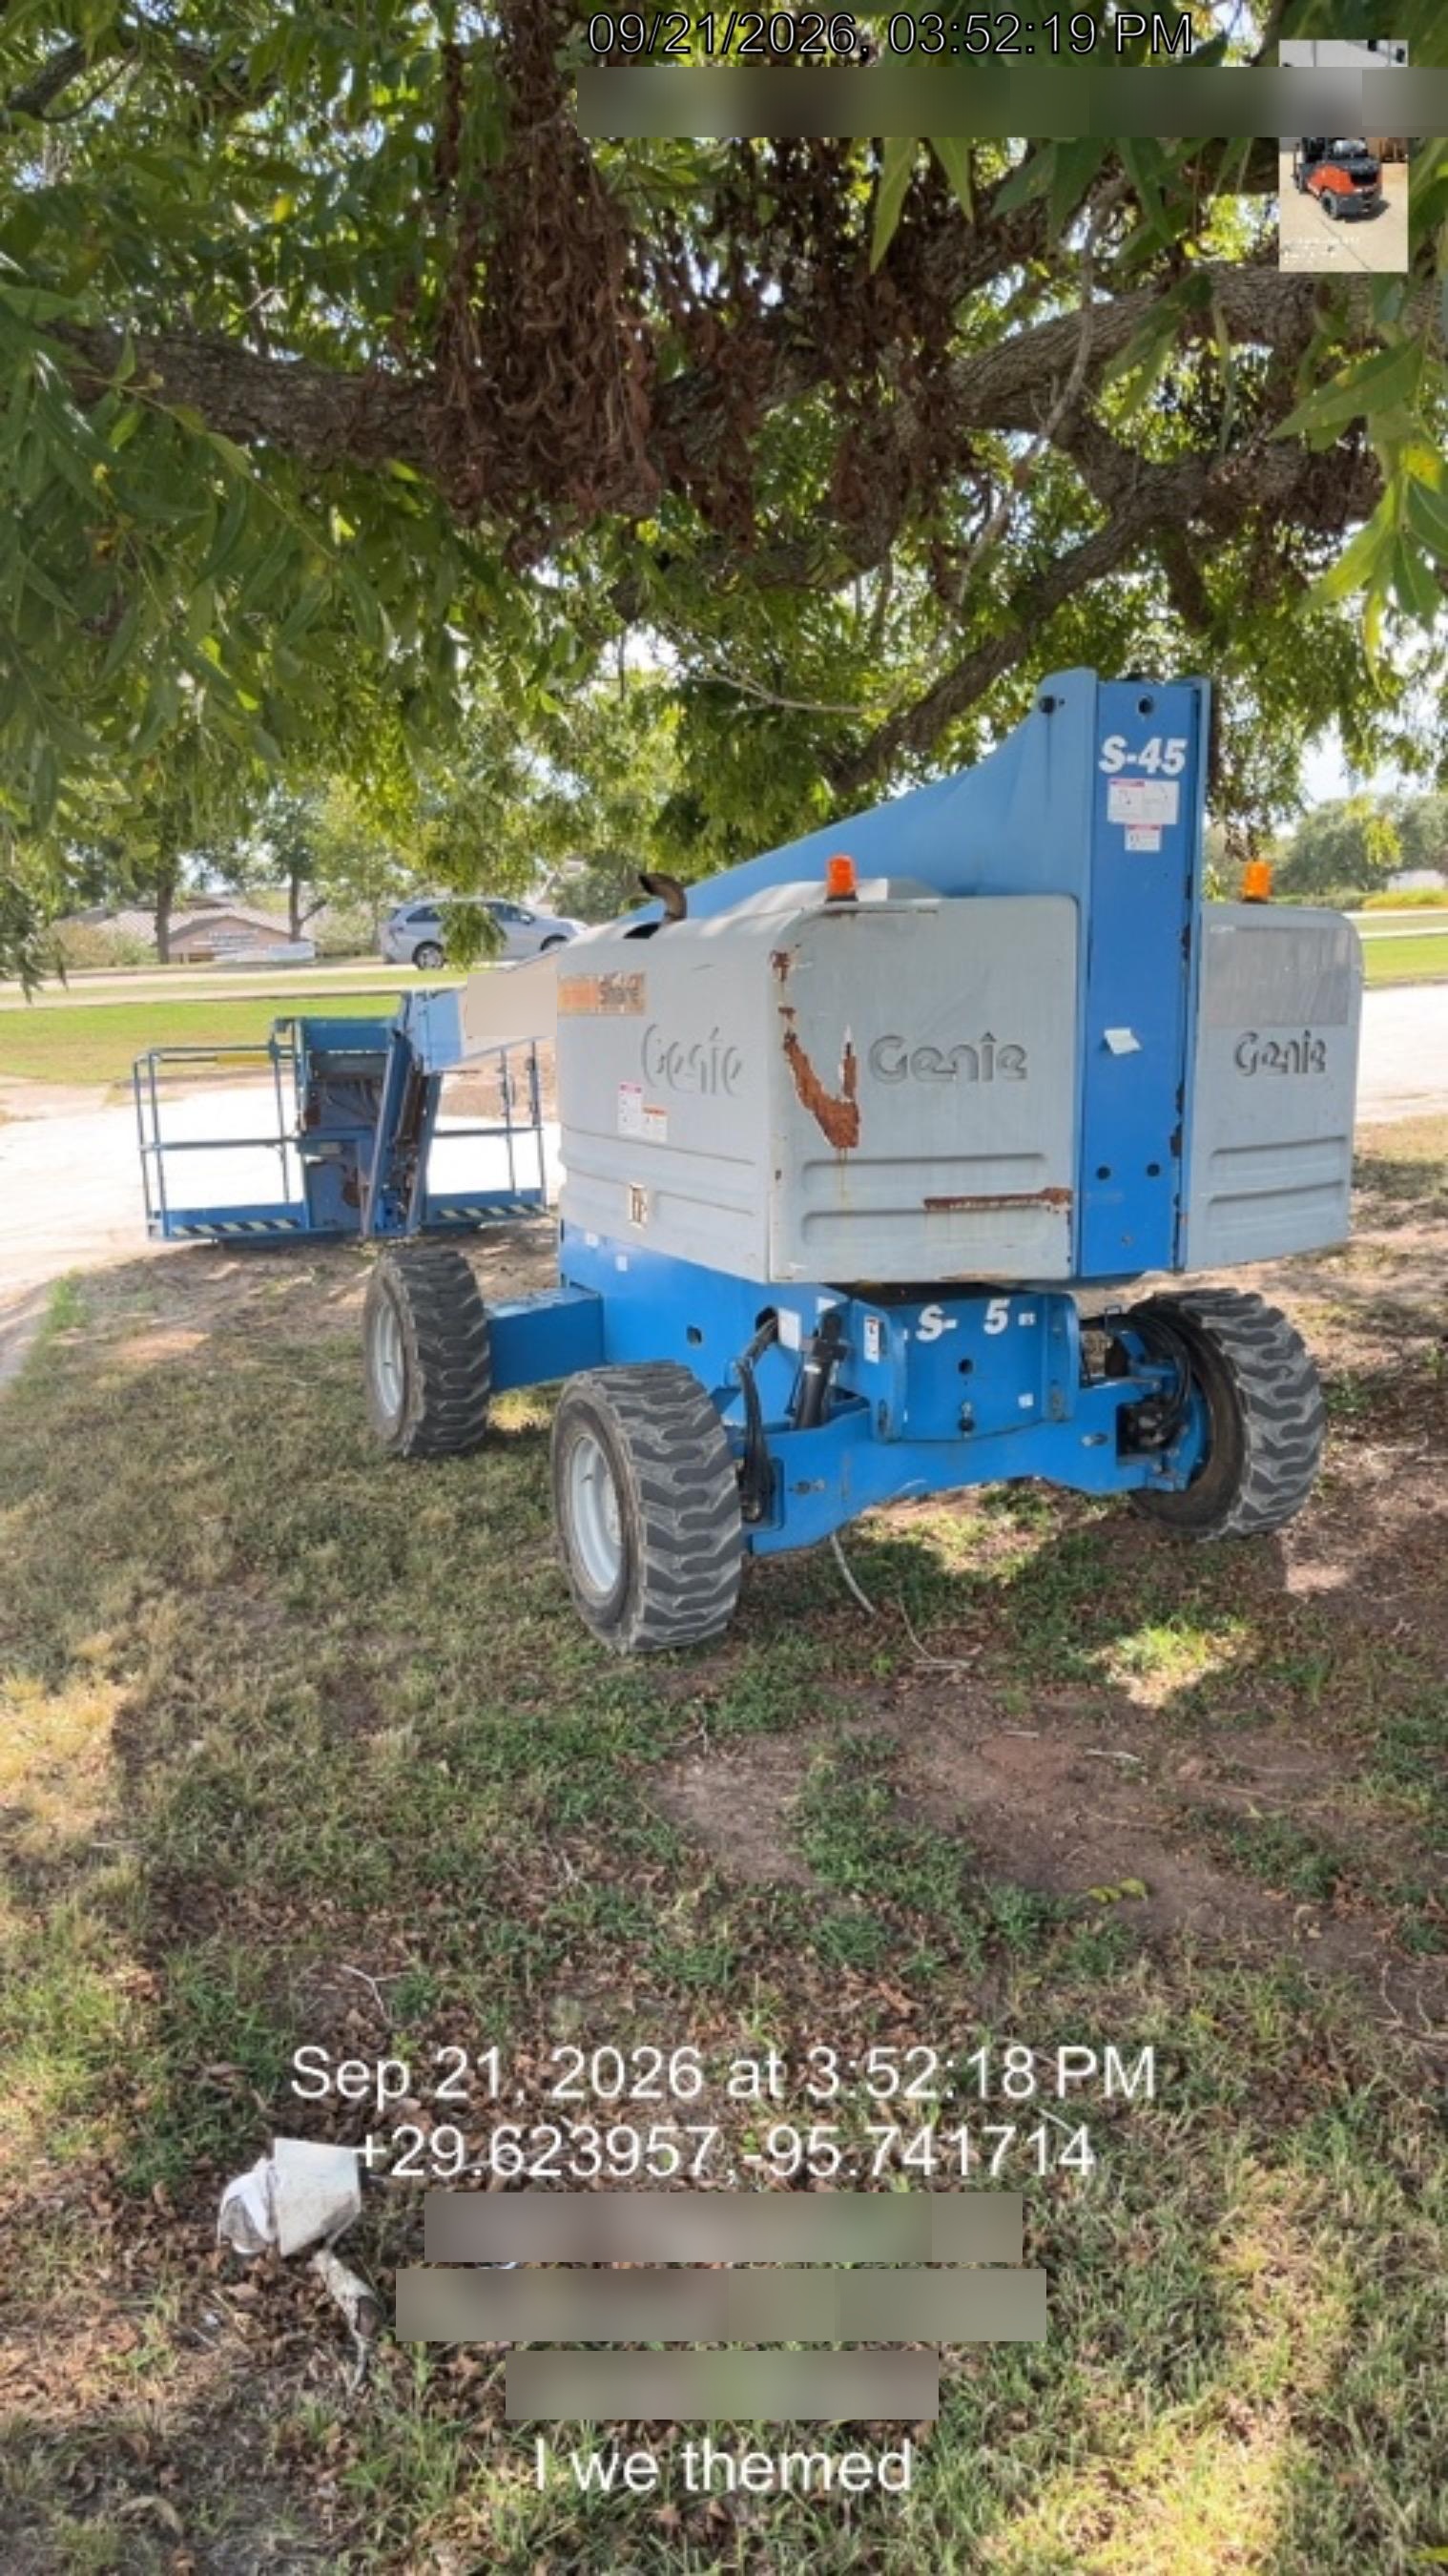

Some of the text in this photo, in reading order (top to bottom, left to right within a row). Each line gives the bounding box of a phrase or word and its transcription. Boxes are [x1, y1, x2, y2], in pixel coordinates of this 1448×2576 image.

[1099, 735, 1189, 776] S-45
[641, 1023, 744, 1097] Genie
[868, 1030, 1028, 1085] Genie
[1234, 1028, 1327, 1078] Genie
